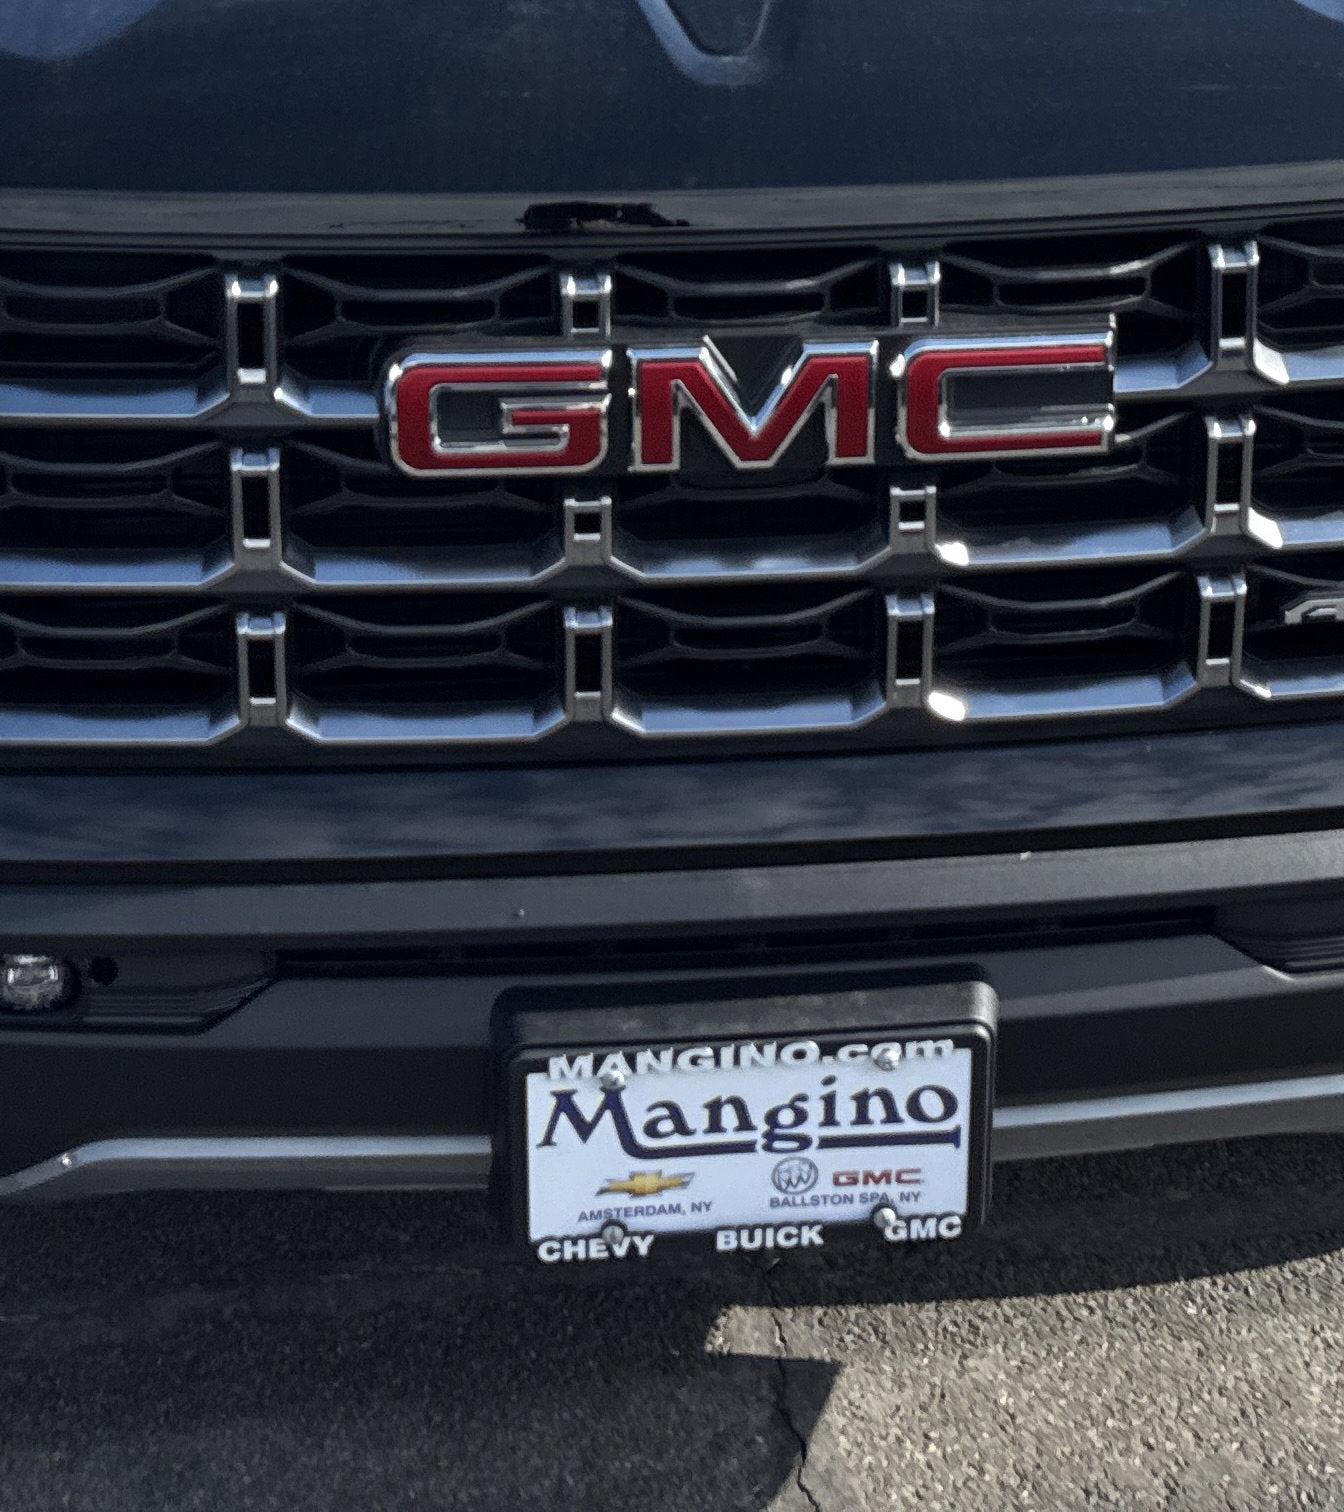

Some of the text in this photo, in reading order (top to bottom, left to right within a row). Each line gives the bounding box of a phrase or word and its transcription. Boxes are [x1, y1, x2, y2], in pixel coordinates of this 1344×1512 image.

[388, 328, 1116, 478] GMC
[547, 1039, 955, 1081] MANGINO.com
[535, 1074, 962, 1159] Mangino
[832, 1167, 922, 1187] GMC
[577, 1199, 713, 1223] AMSTERDAM, NY
[769, 1193, 855, 1209] BALLSTON
[899, 1190, 922, 1204] NY
[537, 1215, 962, 1263] CHEVY BUICK GMC
